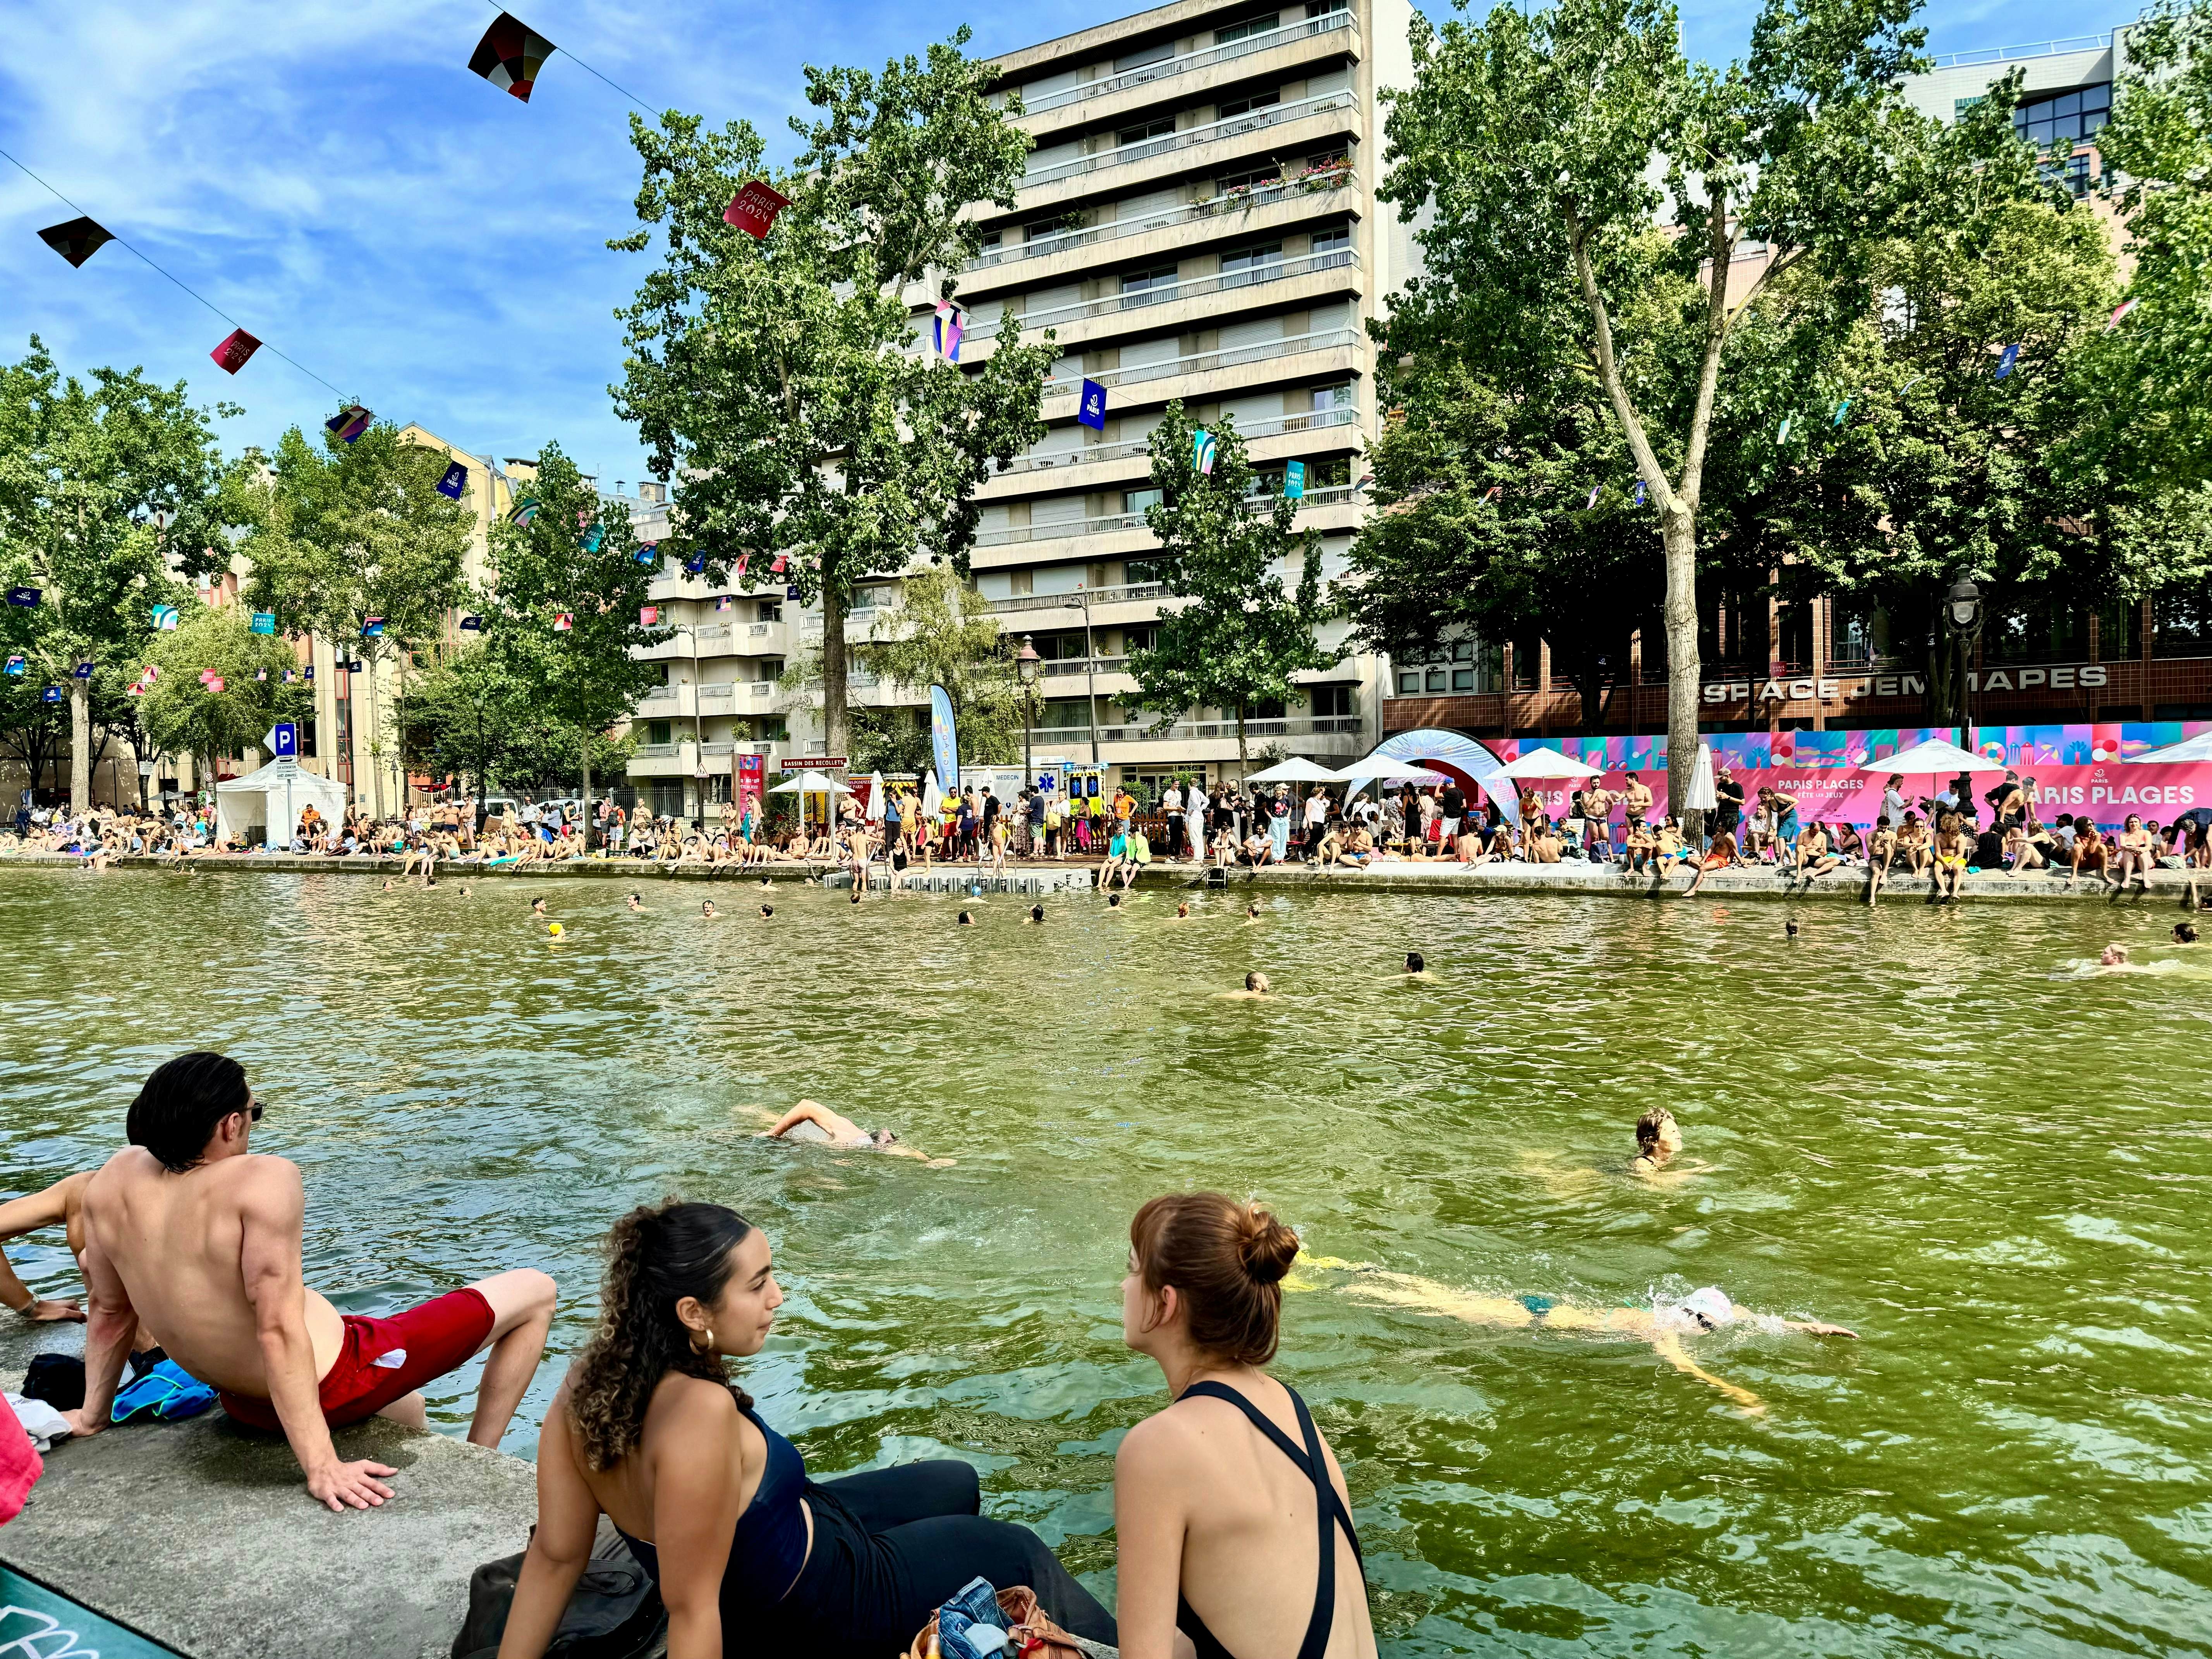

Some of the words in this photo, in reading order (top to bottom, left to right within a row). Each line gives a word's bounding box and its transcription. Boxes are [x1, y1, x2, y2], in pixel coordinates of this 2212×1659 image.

[744, 190, 775, 210] PARIS
[737, 200, 768, 222] 2024
[231, 341, 249, 356] PARIS
[1087, 404, 1099, 415] PARIS
[447, 478, 458, 487] PARIS
[1288, 471, 1301, 480] PARIS
[1288, 479, 1300, 487] 2024
[1697, 678, 1839, 703] SPACE
[280, 731, 290, 749] P
[1778, 780, 1813, 789] PARIS
[1815, 779, 1864, 789] PLAGES
[1534, 790, 1564, 806] RIS
[2032, 787, 2084, 804] ARIS
[2092, 786, 2194, 804] PLAGES
